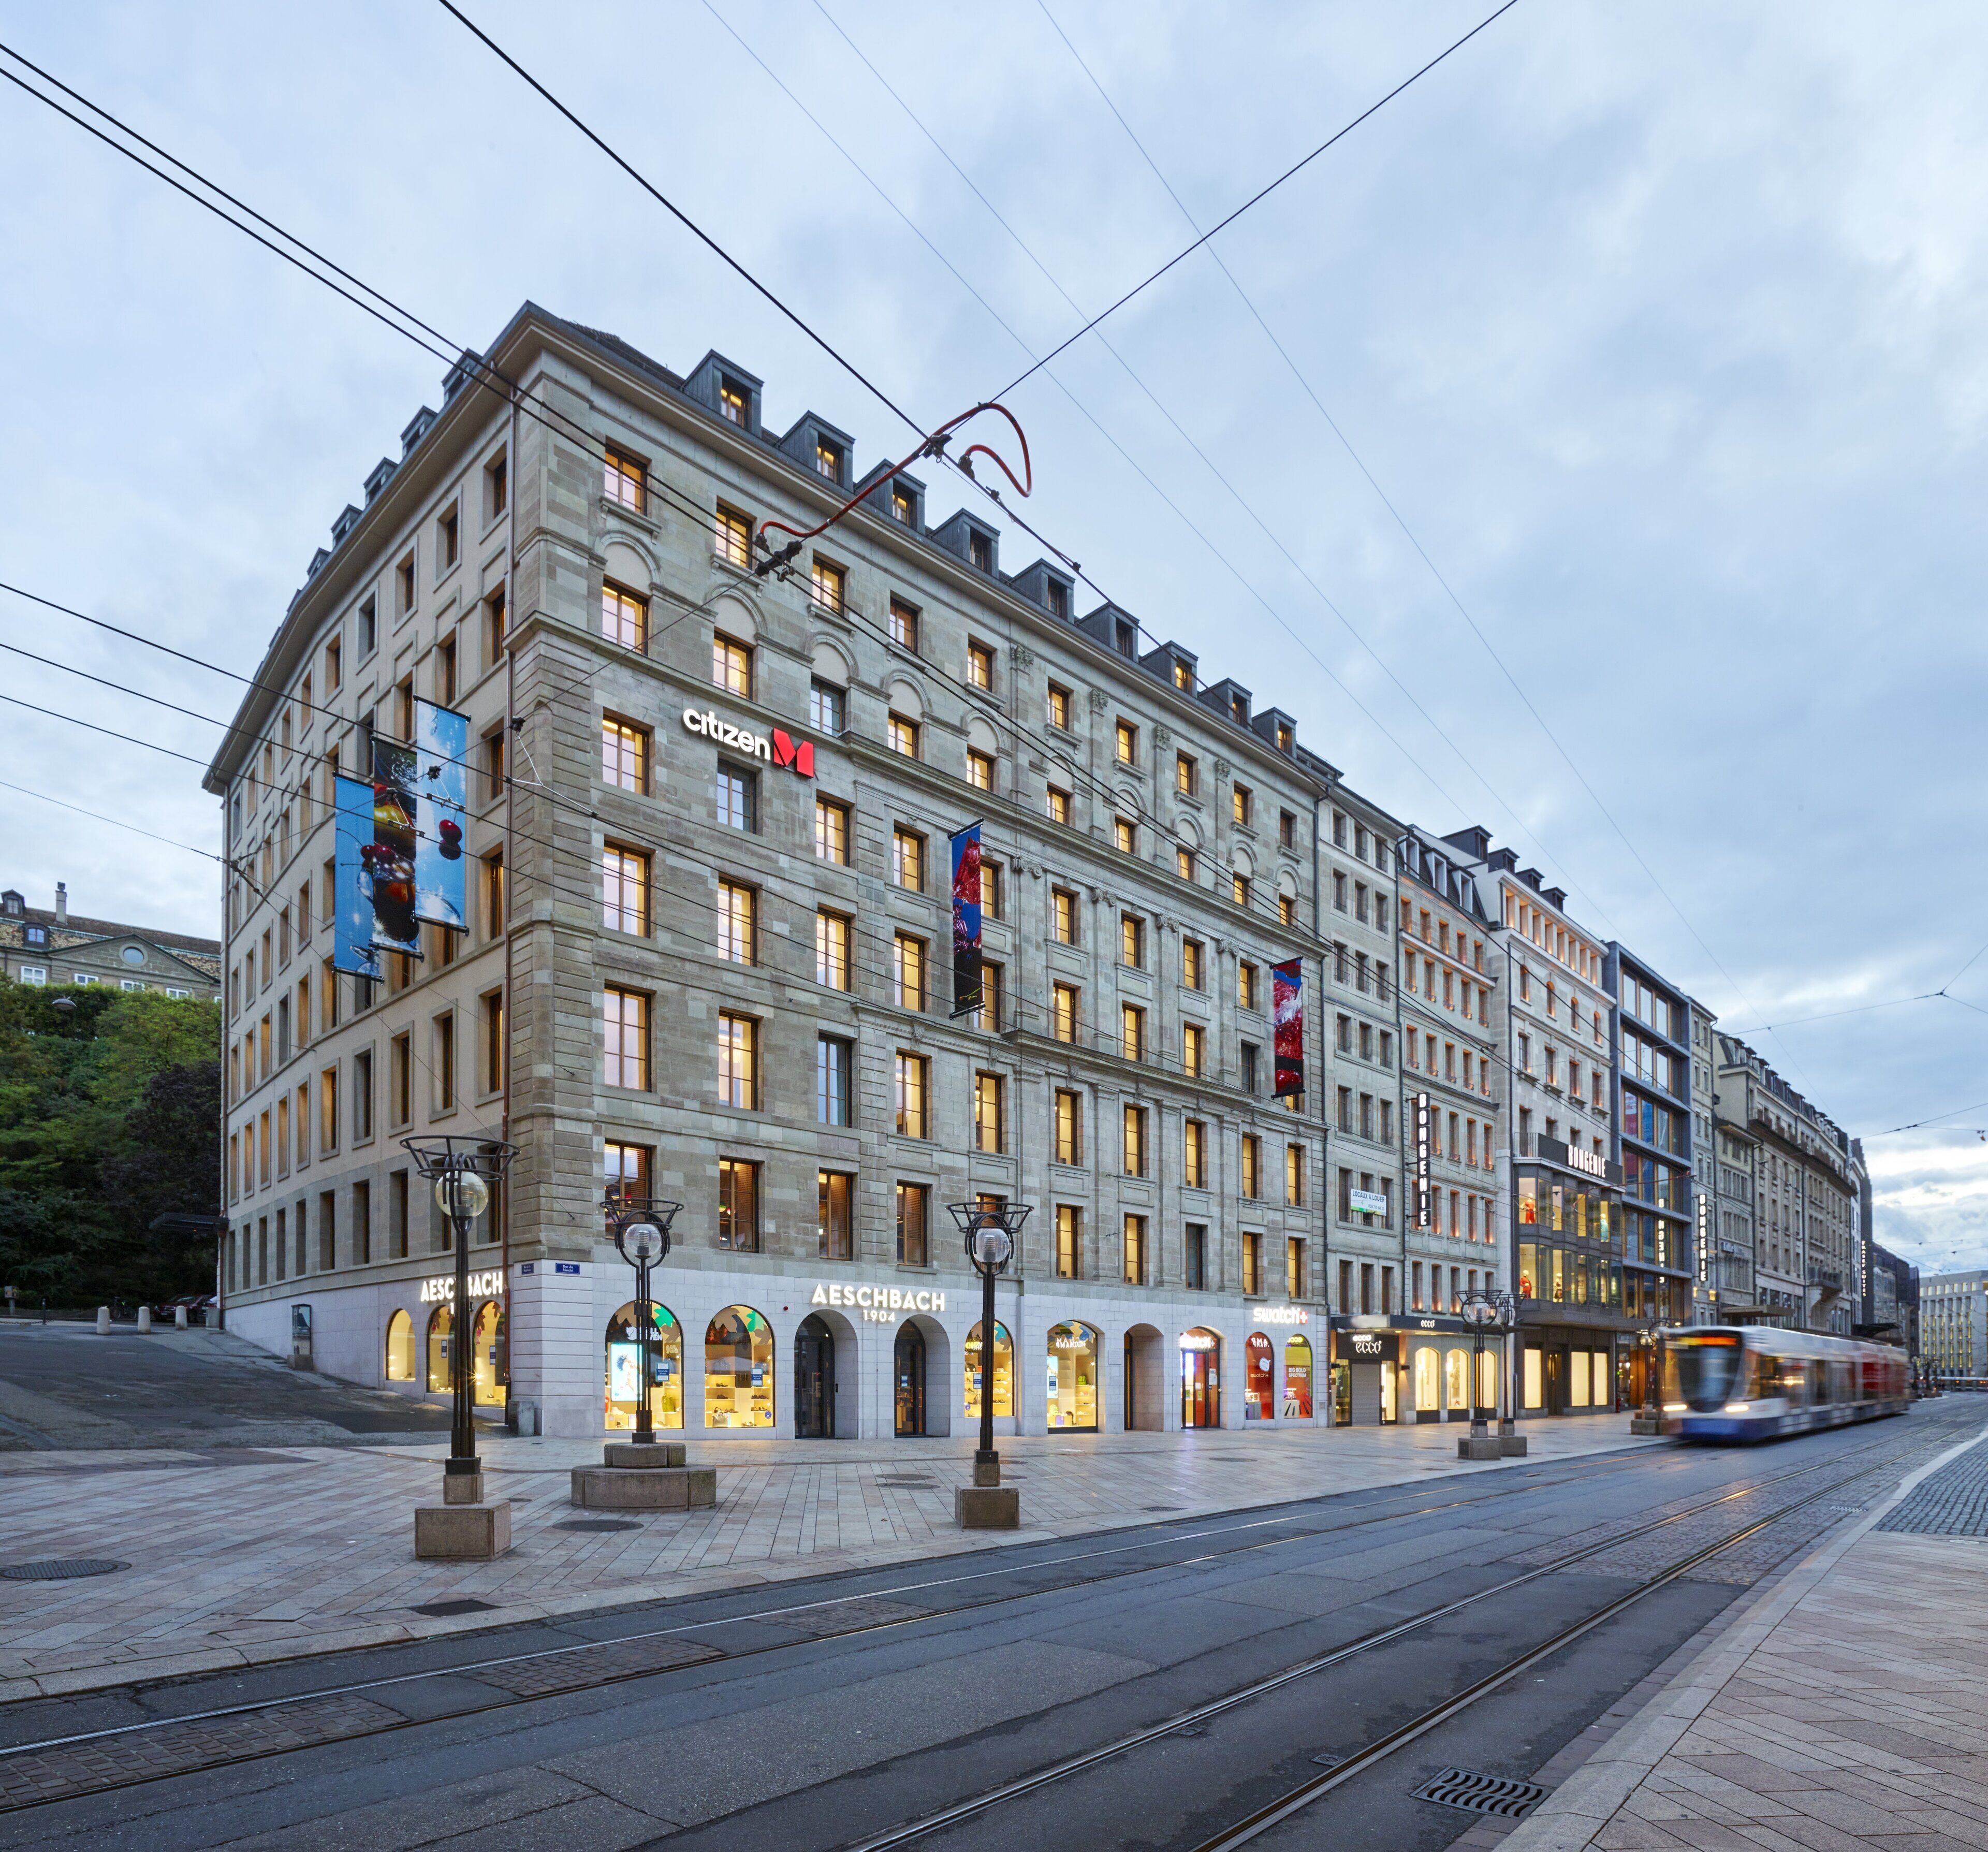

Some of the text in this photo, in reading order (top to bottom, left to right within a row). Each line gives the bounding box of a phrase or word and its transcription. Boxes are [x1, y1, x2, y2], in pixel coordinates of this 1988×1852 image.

[683, 709, 814, 778] citizenM
[1419, 1093, 1427, 1226] BONGENIE
[1568, 1144, 1605, 1178] BONGENIE
[1352, 1190, 1368, 1199] LOCAUX
[421, 1272, 503, 1302] AESCBACH
[811, 1284, 945, 1311] AESCHBACH
[863, 1309, 896, 1322] 1904
[1421, 1320, 1435, 1328] ecco
[1355, 1340, 1382, 1353] ecco
